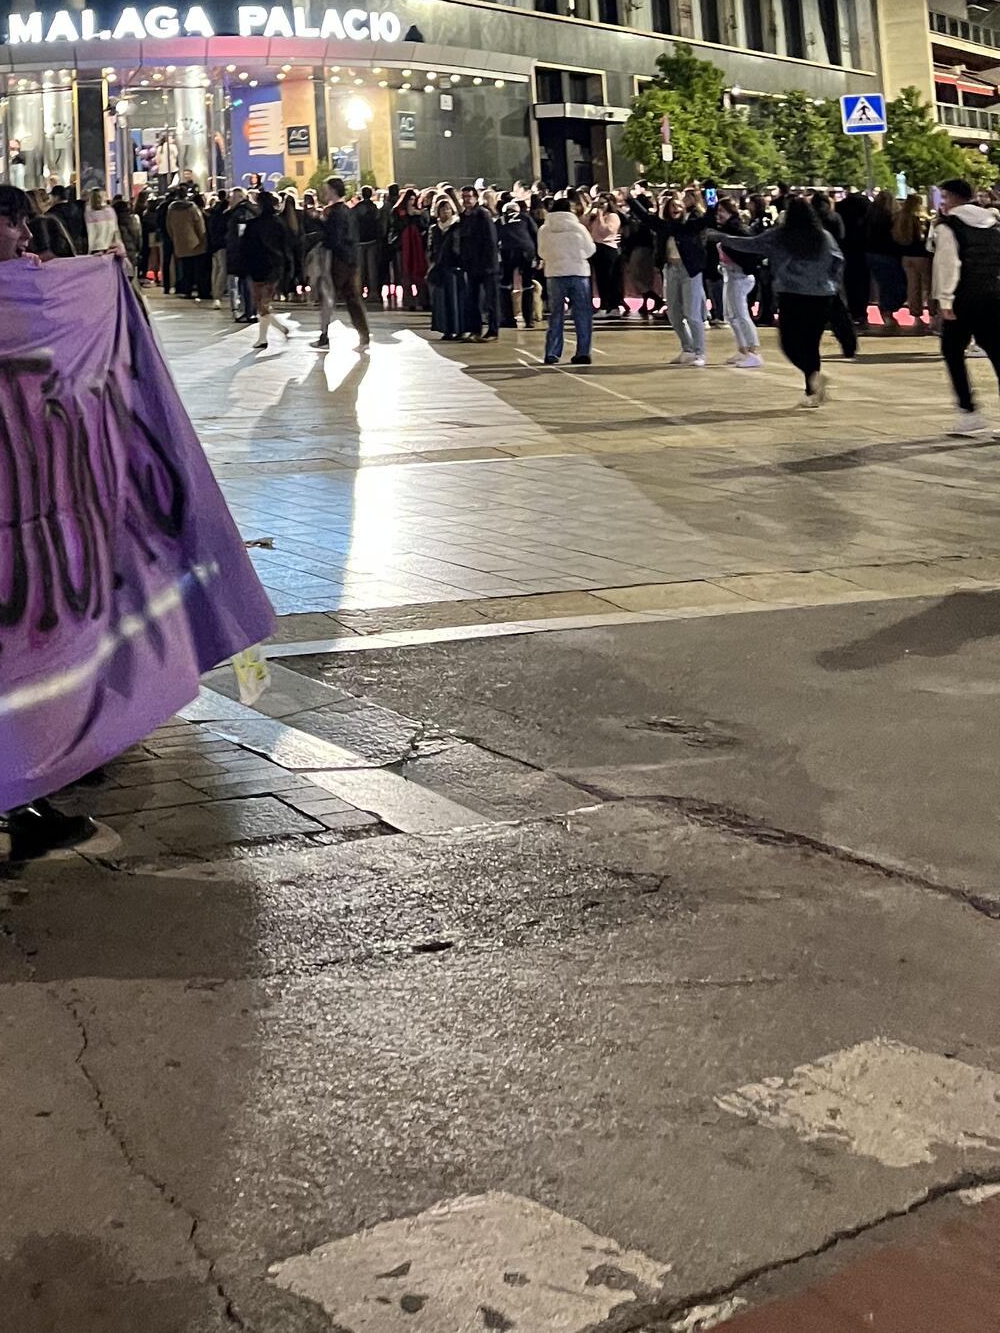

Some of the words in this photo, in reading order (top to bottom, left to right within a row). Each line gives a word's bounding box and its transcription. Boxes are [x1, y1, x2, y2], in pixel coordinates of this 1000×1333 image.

[8, 5, 214, 45] MALAGA
[237, 5, 401, 43] PALACIO
[289, 128, 309, 141] AC
